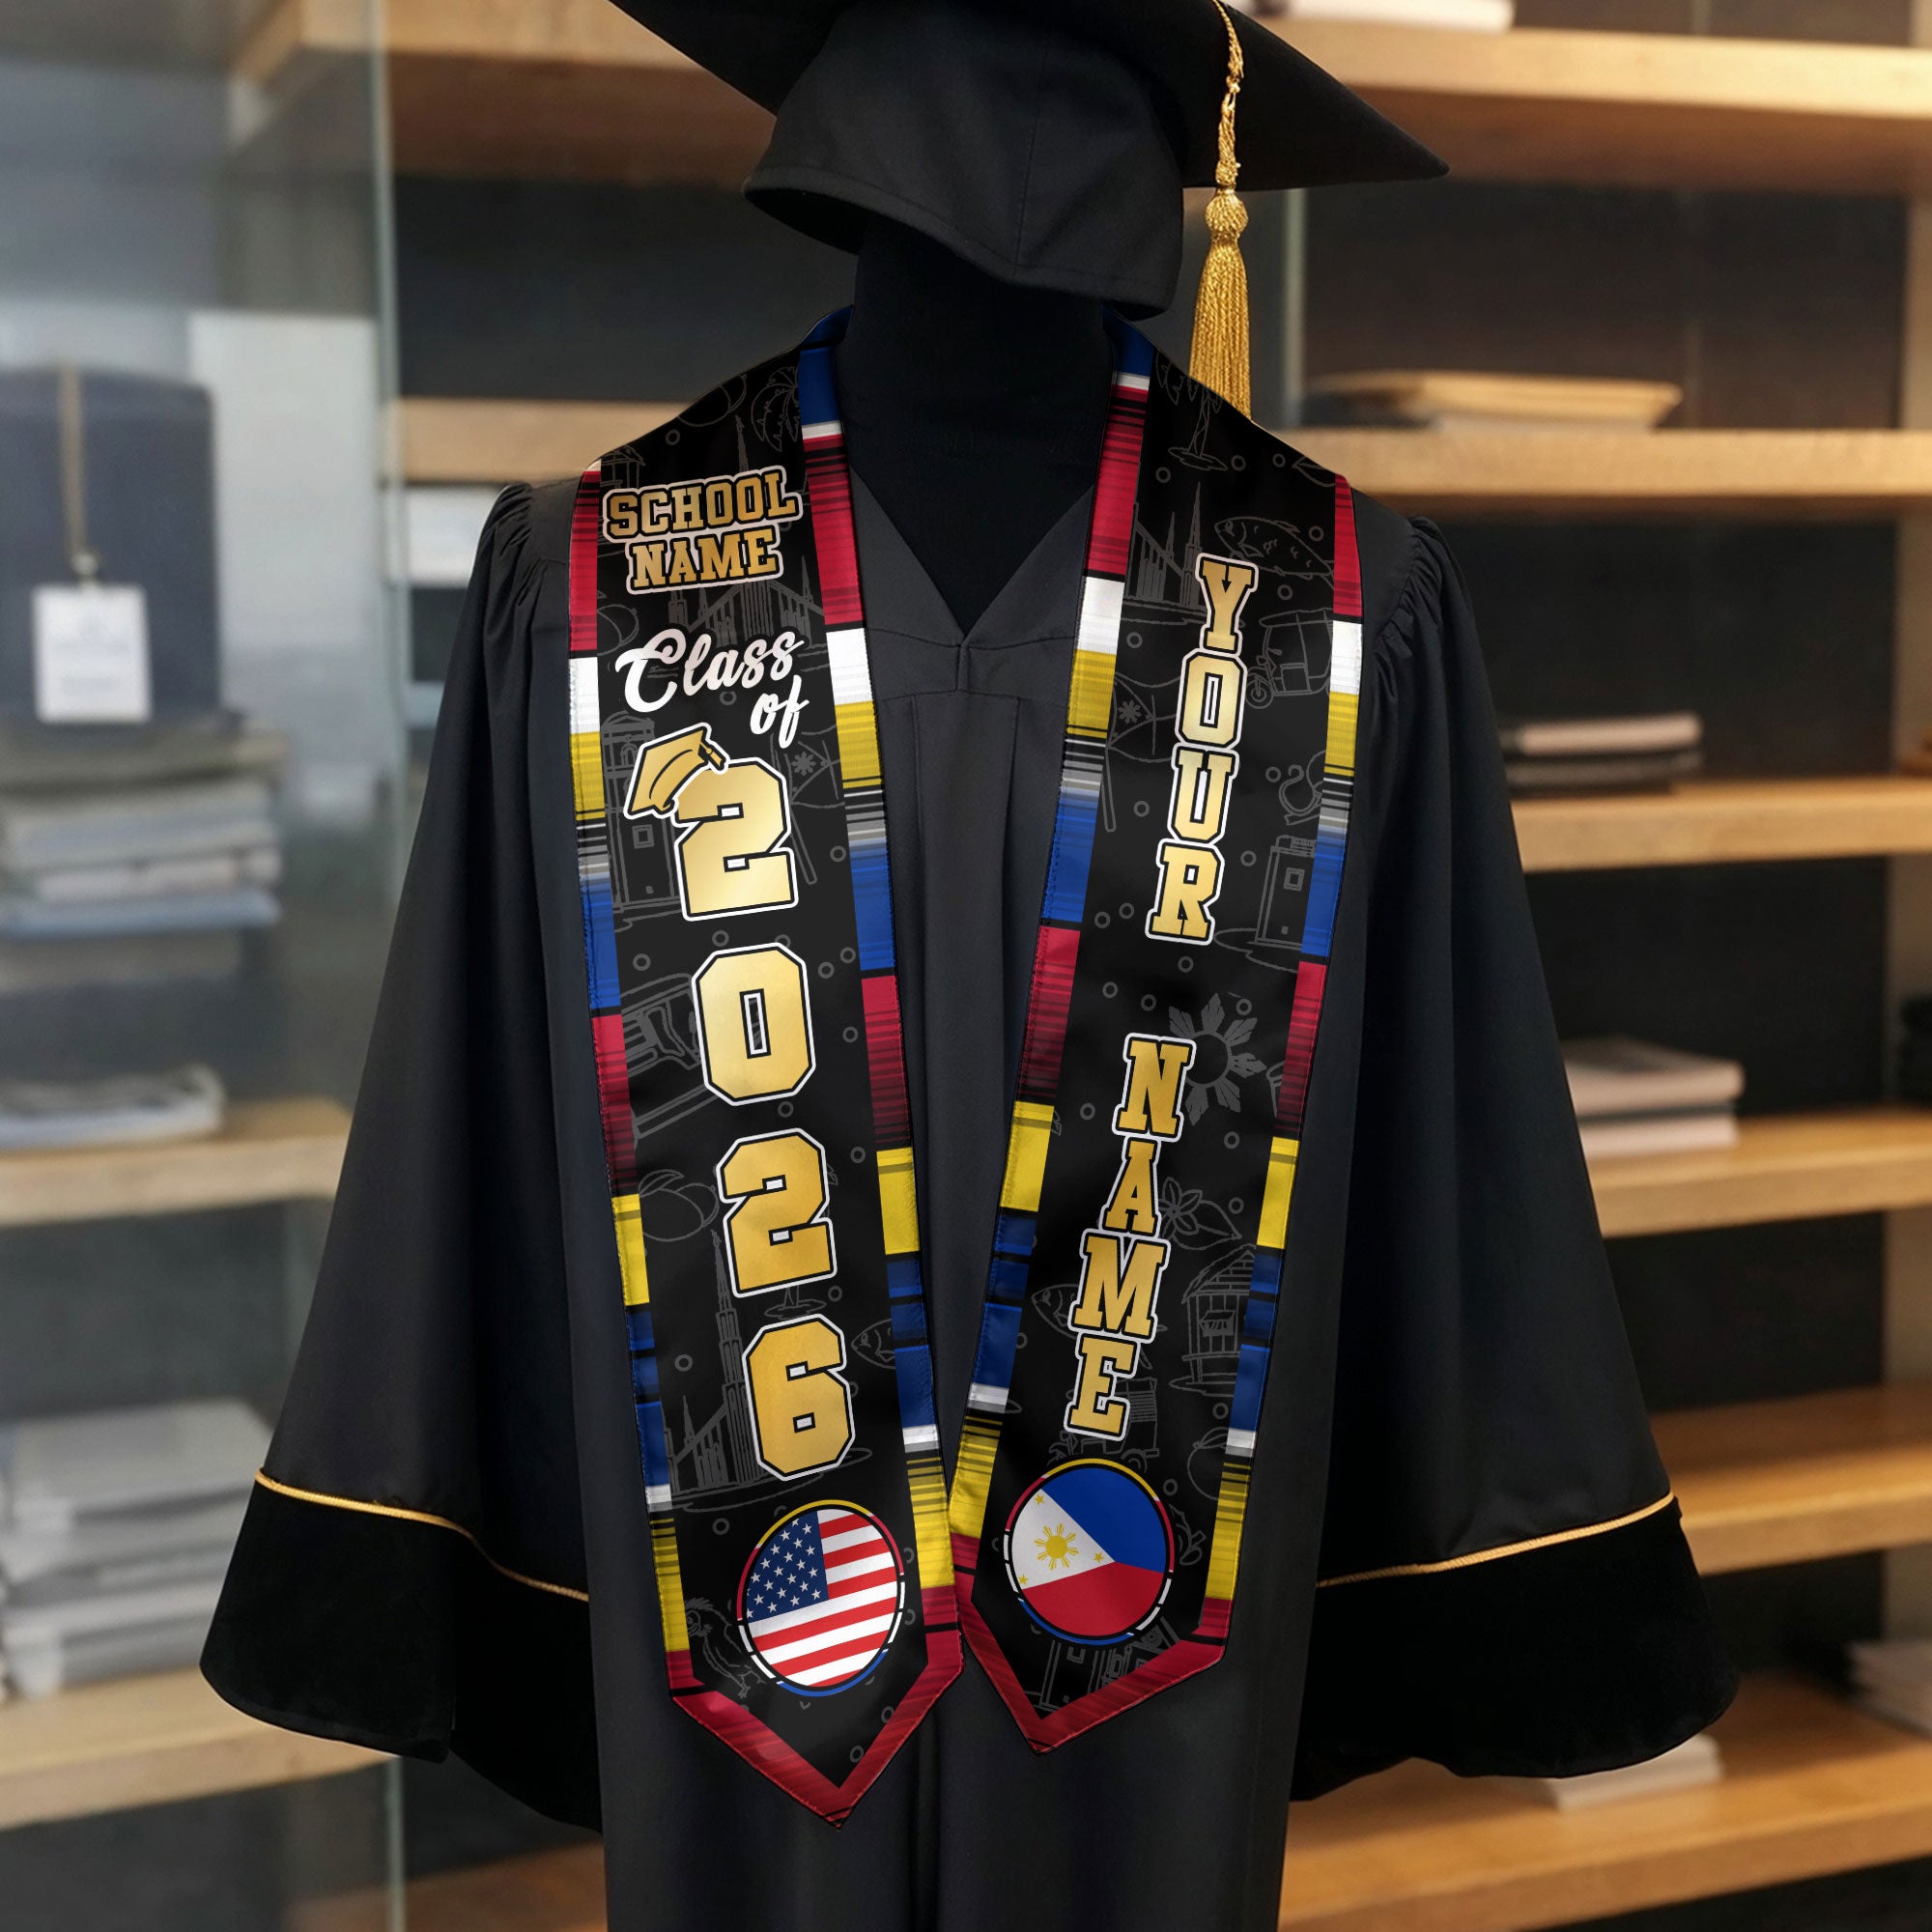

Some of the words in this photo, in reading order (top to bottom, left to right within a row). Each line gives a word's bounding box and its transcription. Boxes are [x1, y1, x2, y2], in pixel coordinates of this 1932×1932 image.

[605, 468, 801, 540] SCHOOL
[629, 526, 781, 591] NAME
[615, 628, 804, 712] Class
[750, 674, 810, 749] of
[1147, 554, 1257, 942] YOUR
[673, 758, 855, 1479] 2026
[1065, 1034, 1194, 1439] NAME
